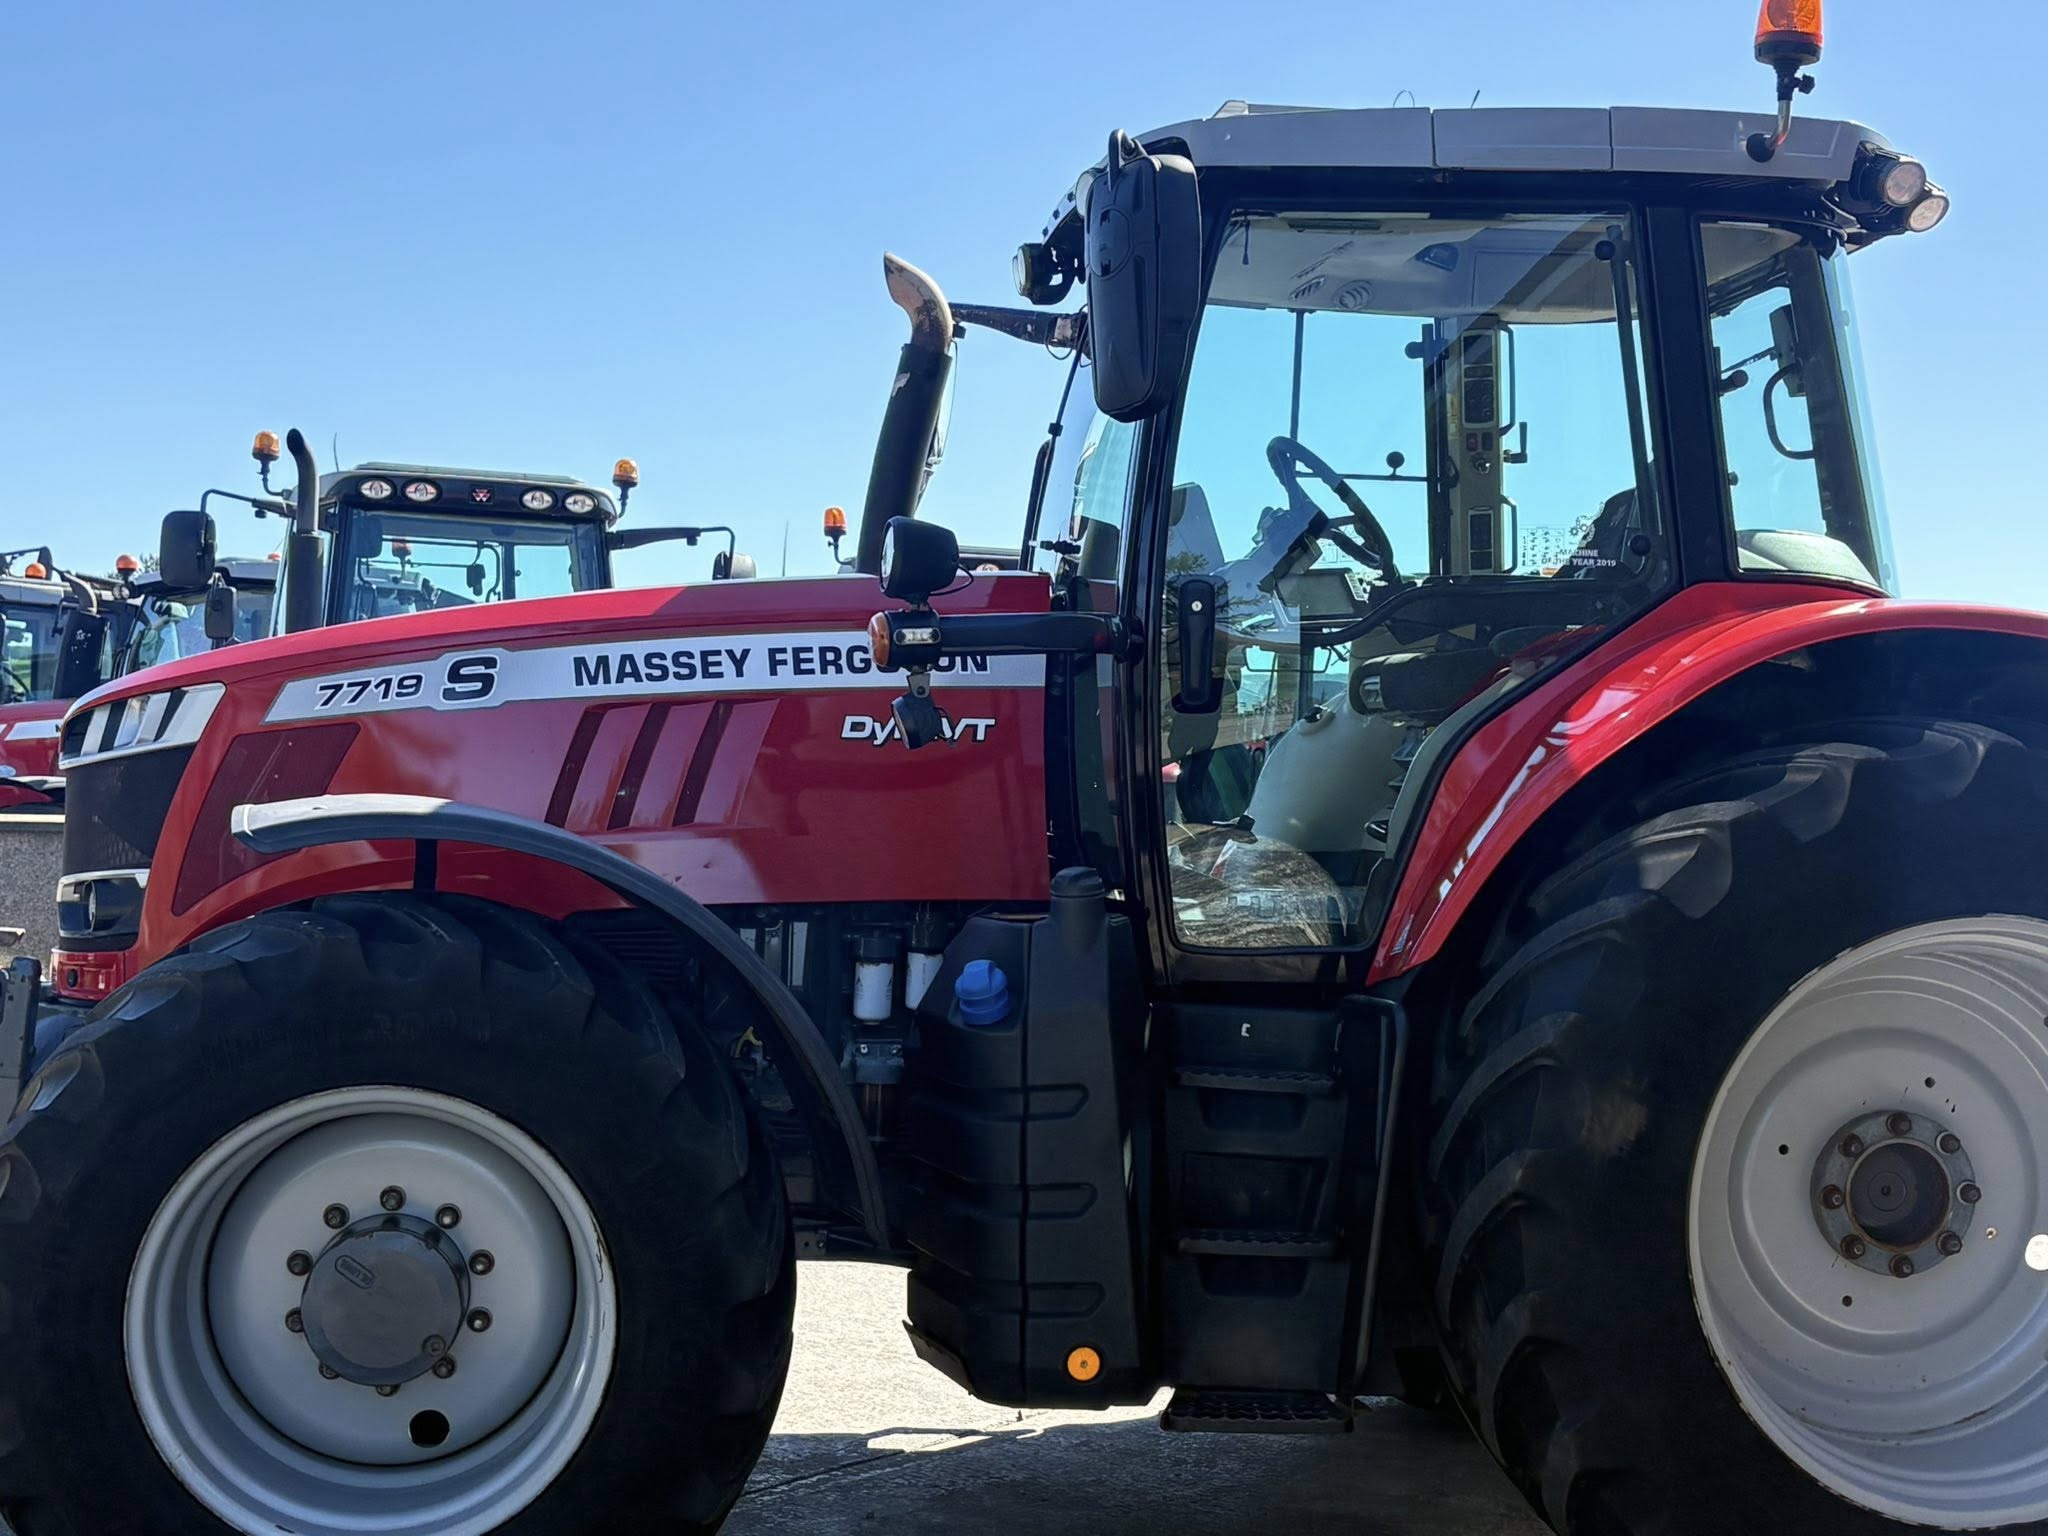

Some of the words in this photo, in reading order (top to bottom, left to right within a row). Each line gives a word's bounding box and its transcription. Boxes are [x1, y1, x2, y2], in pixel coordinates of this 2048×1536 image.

[1572, 558, 1595, 566] YEAR
[1596, 559, 1617, 567] 2019
[318, 674, 423, 707] 7719
[442, 656, 498, 701] S
[573, 648, 752, 687] MASSEY
[768, 645, 989, 676] FERGON
